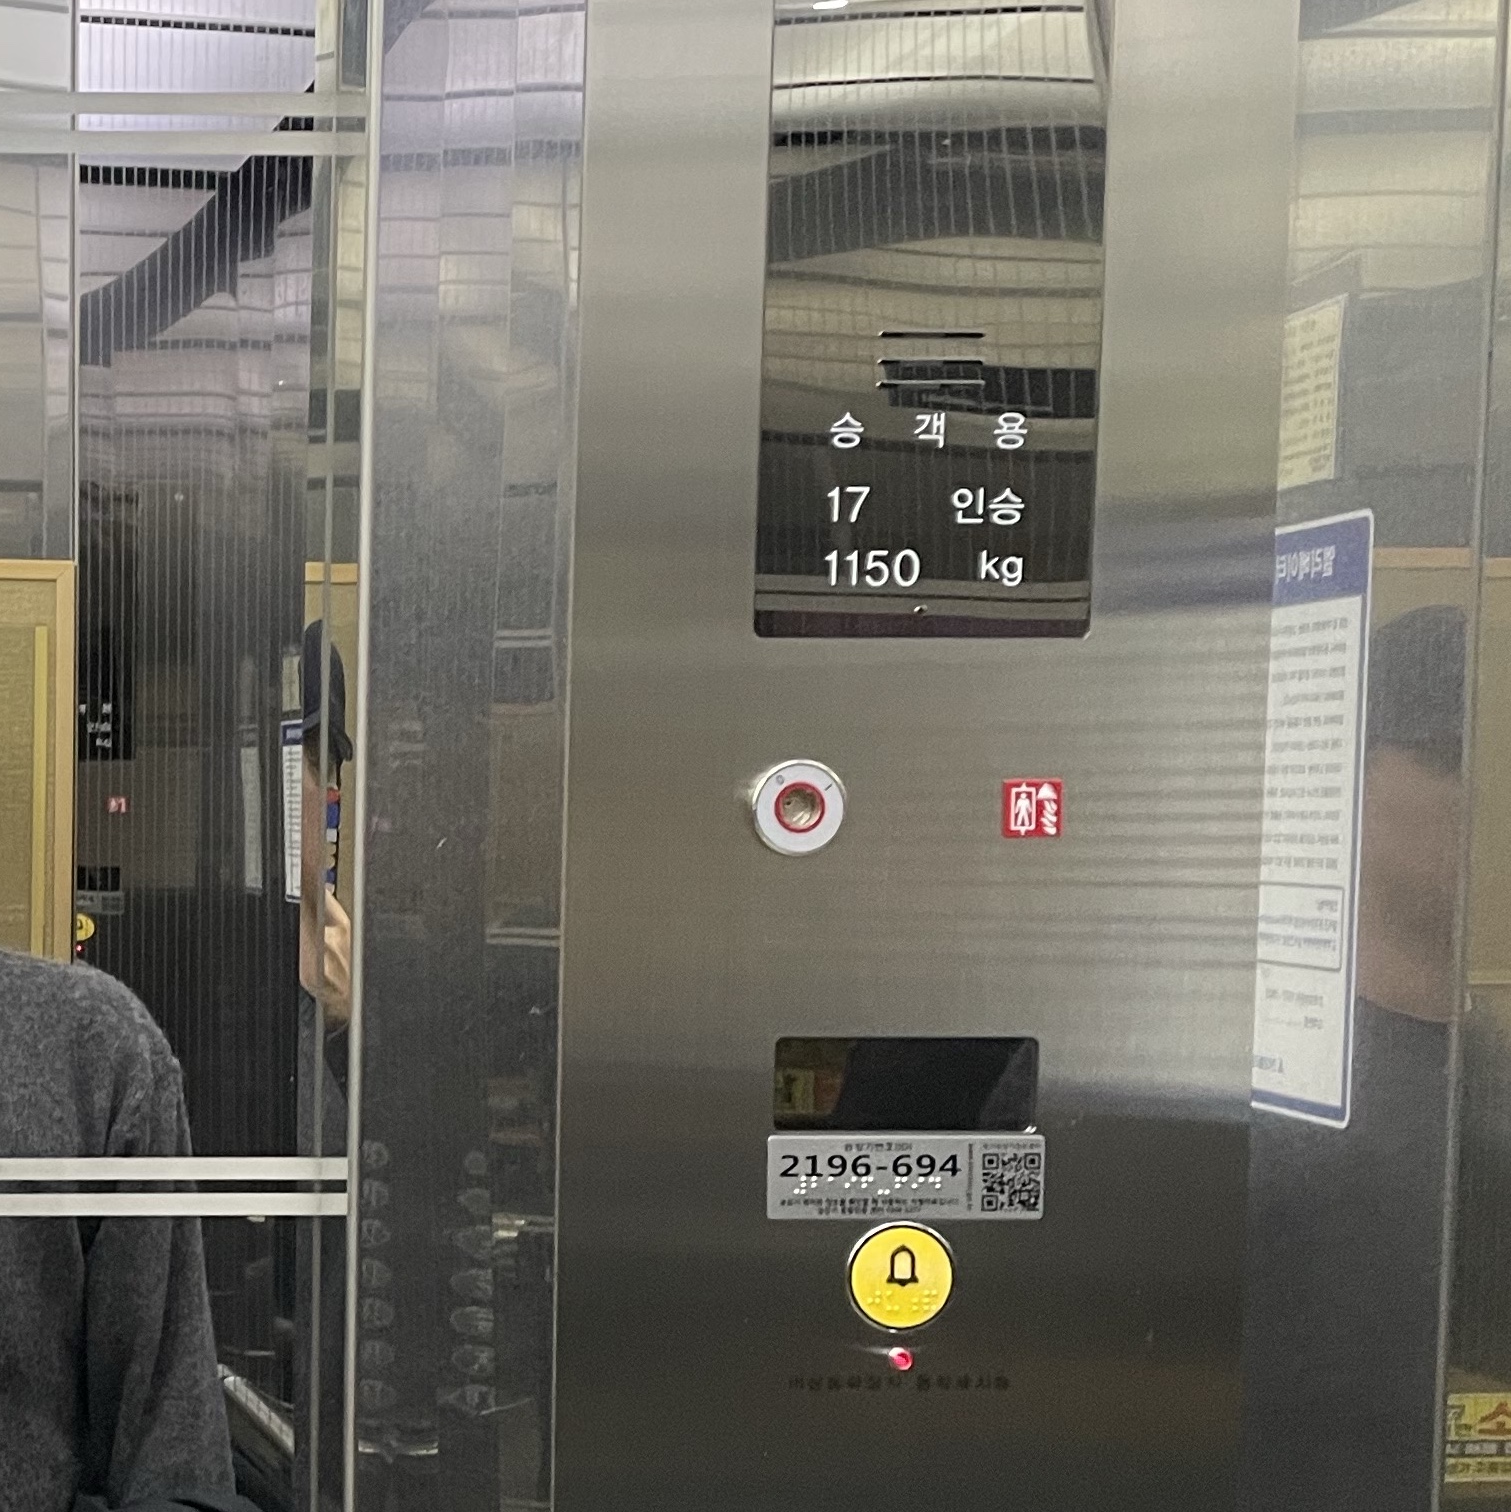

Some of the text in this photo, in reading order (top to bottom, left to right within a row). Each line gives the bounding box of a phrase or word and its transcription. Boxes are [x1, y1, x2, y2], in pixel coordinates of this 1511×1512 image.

[827, 486, 1025, 525] 17 인승
[825, 549, 1023, 587] 1150 kg
[780, 1154, 961, 1178] 2196-694
